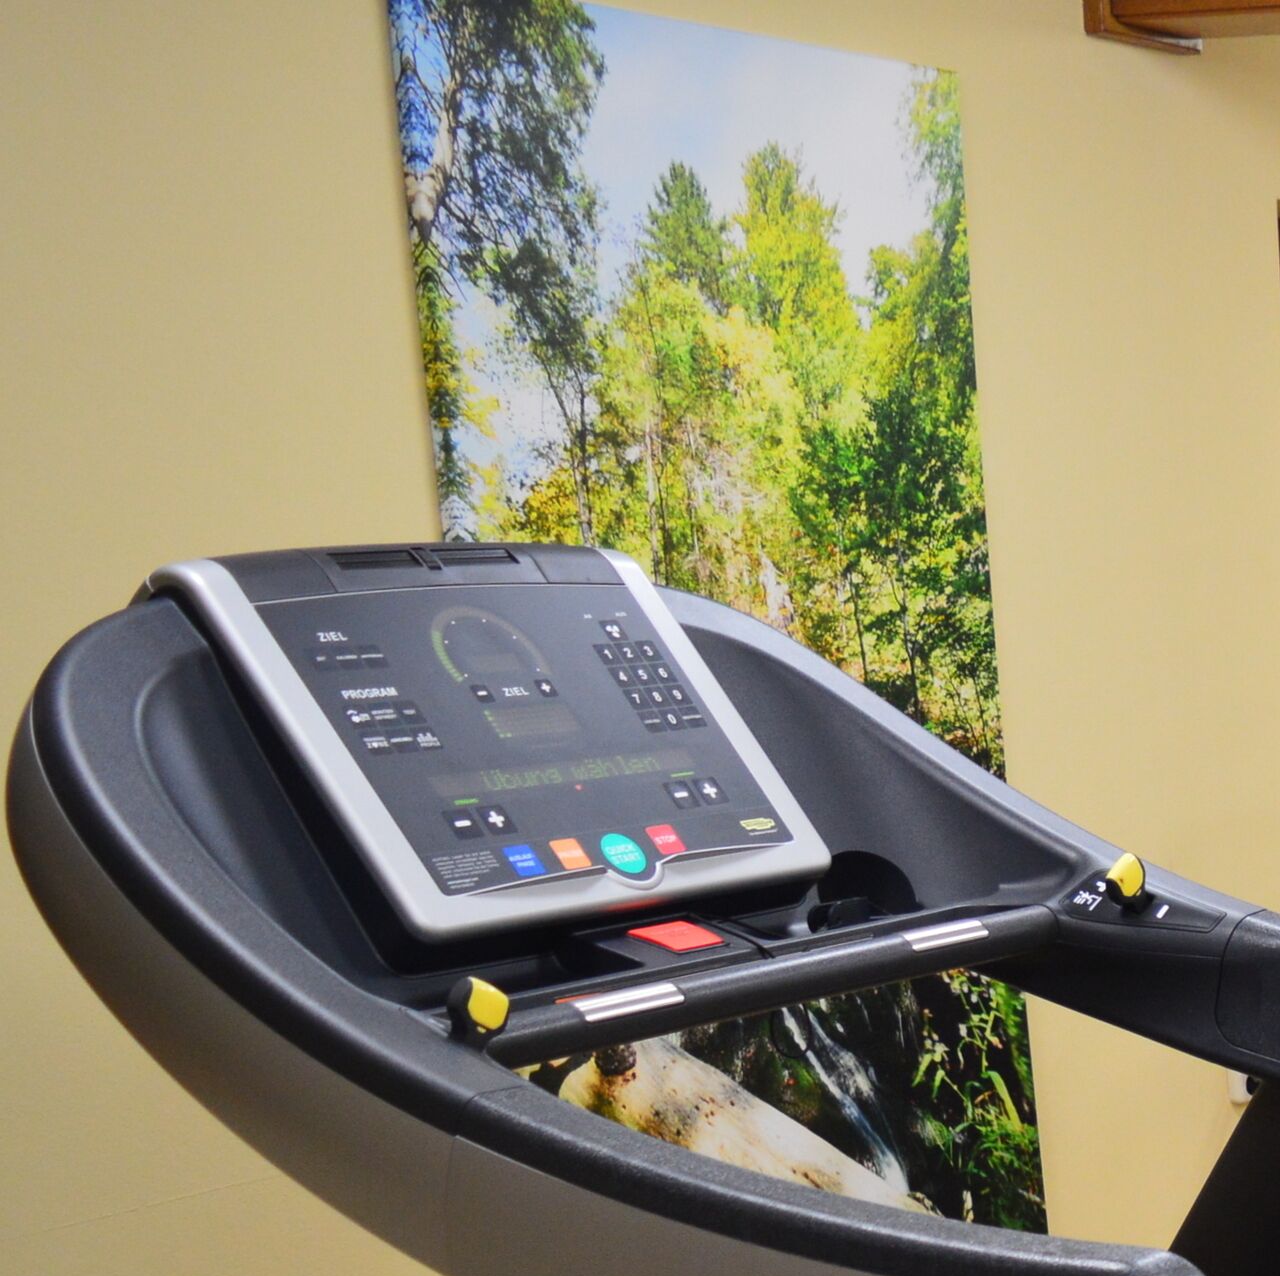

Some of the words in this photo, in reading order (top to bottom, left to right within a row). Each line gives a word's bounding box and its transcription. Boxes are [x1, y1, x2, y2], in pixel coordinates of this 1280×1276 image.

[317, 632, 348, 642] ZIEL
[623, 647, 634, 658] 2
[643, 645, 654, 656] 3
[637, 669, 648, 680] 5
[658, 667, 668, 678] 6
[341, 687, 398, 699] PROGRAM
[502, 686, 529, 697] ZIEL
[652, 691, 662, 702] 8
[672, 689, 682, 700] 9
[667, 713, 677, 725] 0
[654, 835, 677, 844] STOP
